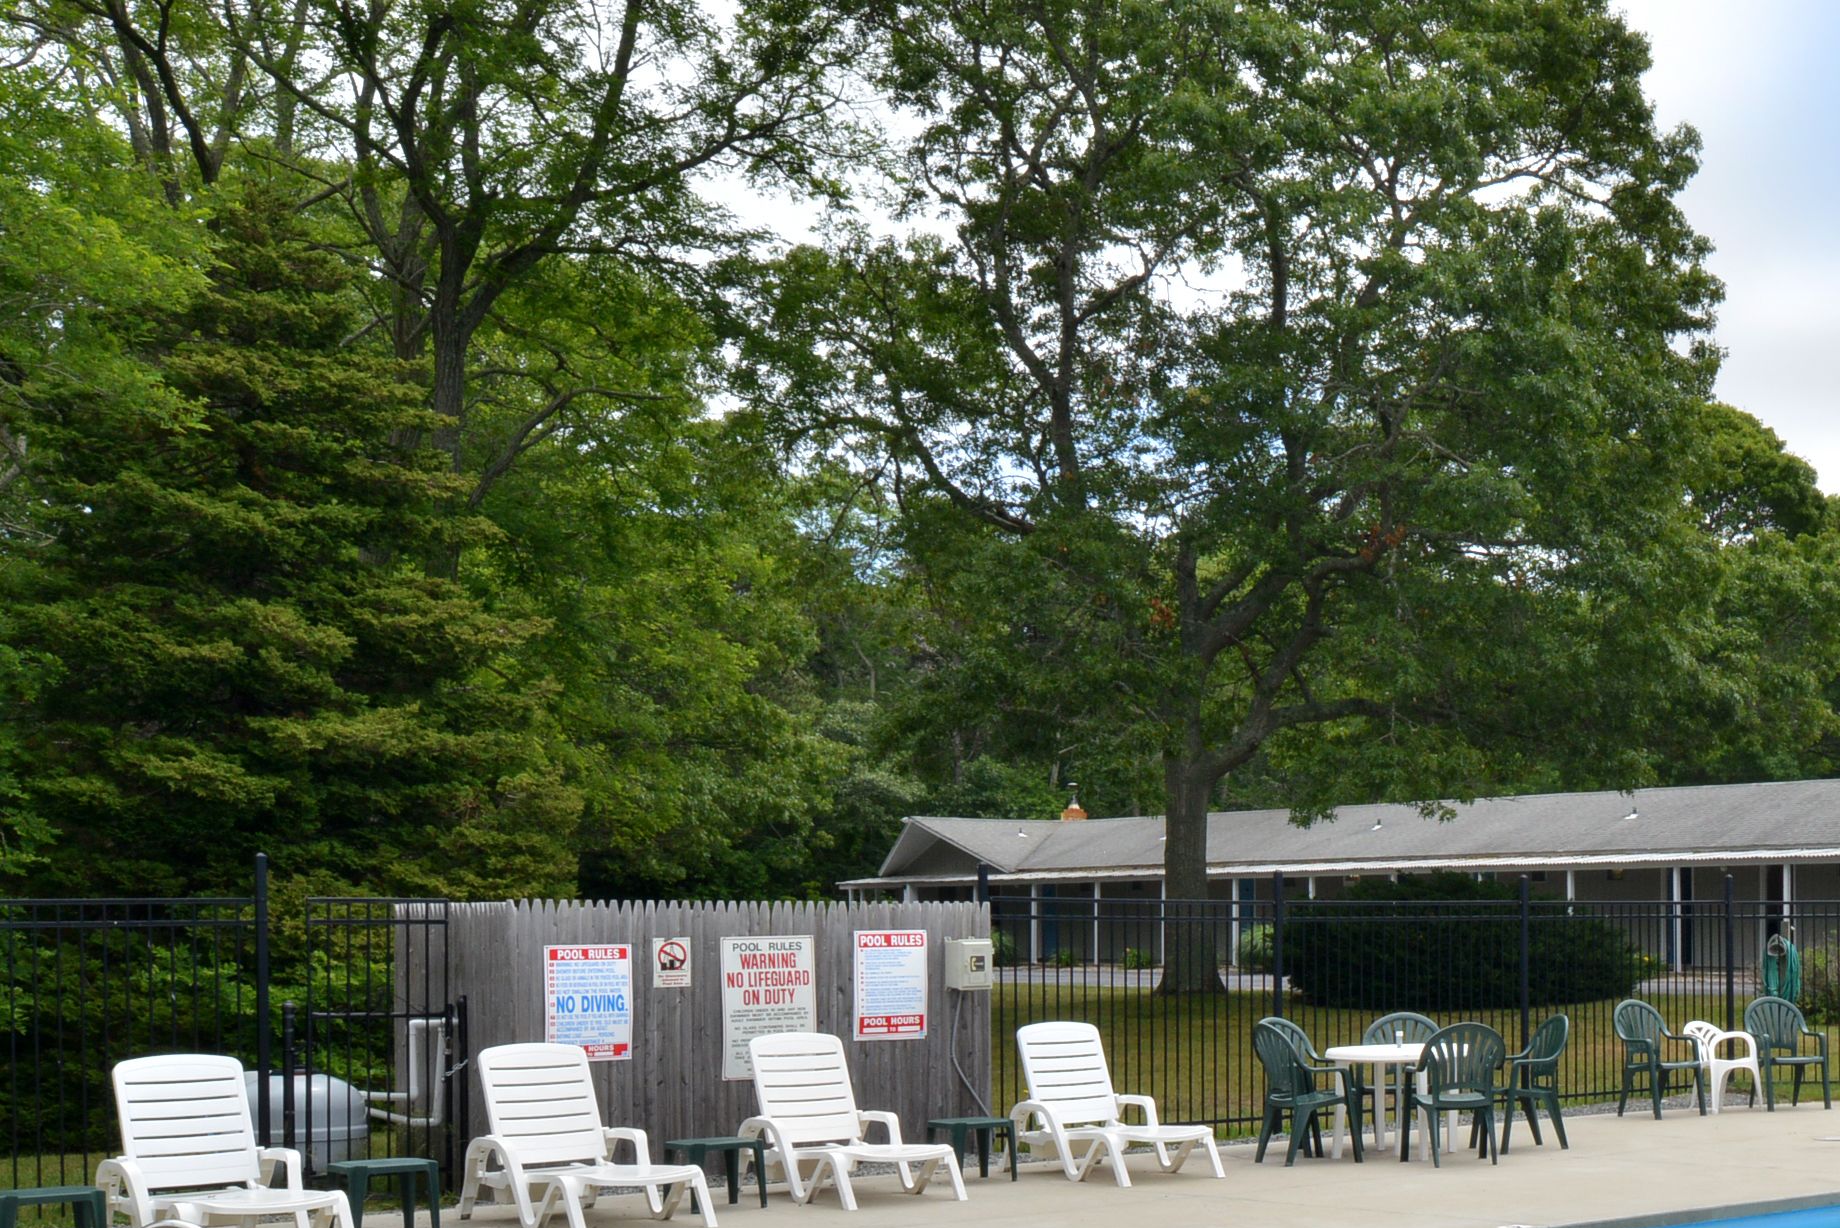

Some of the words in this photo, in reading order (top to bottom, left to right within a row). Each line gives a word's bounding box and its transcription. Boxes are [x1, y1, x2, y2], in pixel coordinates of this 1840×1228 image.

[860, 935, 887, 946] POOL
[891, 934, 922, 946] RULES
[732, 942, 762, 952] POOL
[768, 941, 802, 951] RULES
[557, 949, 584, 960] POOL
[588, 948, 620, 959] RULES
[740, 952, 797, 970] WARNING
[727, 972, 744, 988] NO
[748, 970, 810, 988] LIFEGUARD
[743, 989, 760, 1006] ON
[764, 988, 795, 1005] DUTY
[556, 995, 576, 1013] NO
[581, 994, 628, 1013] DIVING.
[863, 1017, 888, 1026] POOL
[891, 1016, 920, 1025] HOURS
[588, 1043, 614, 1052] HOURS
